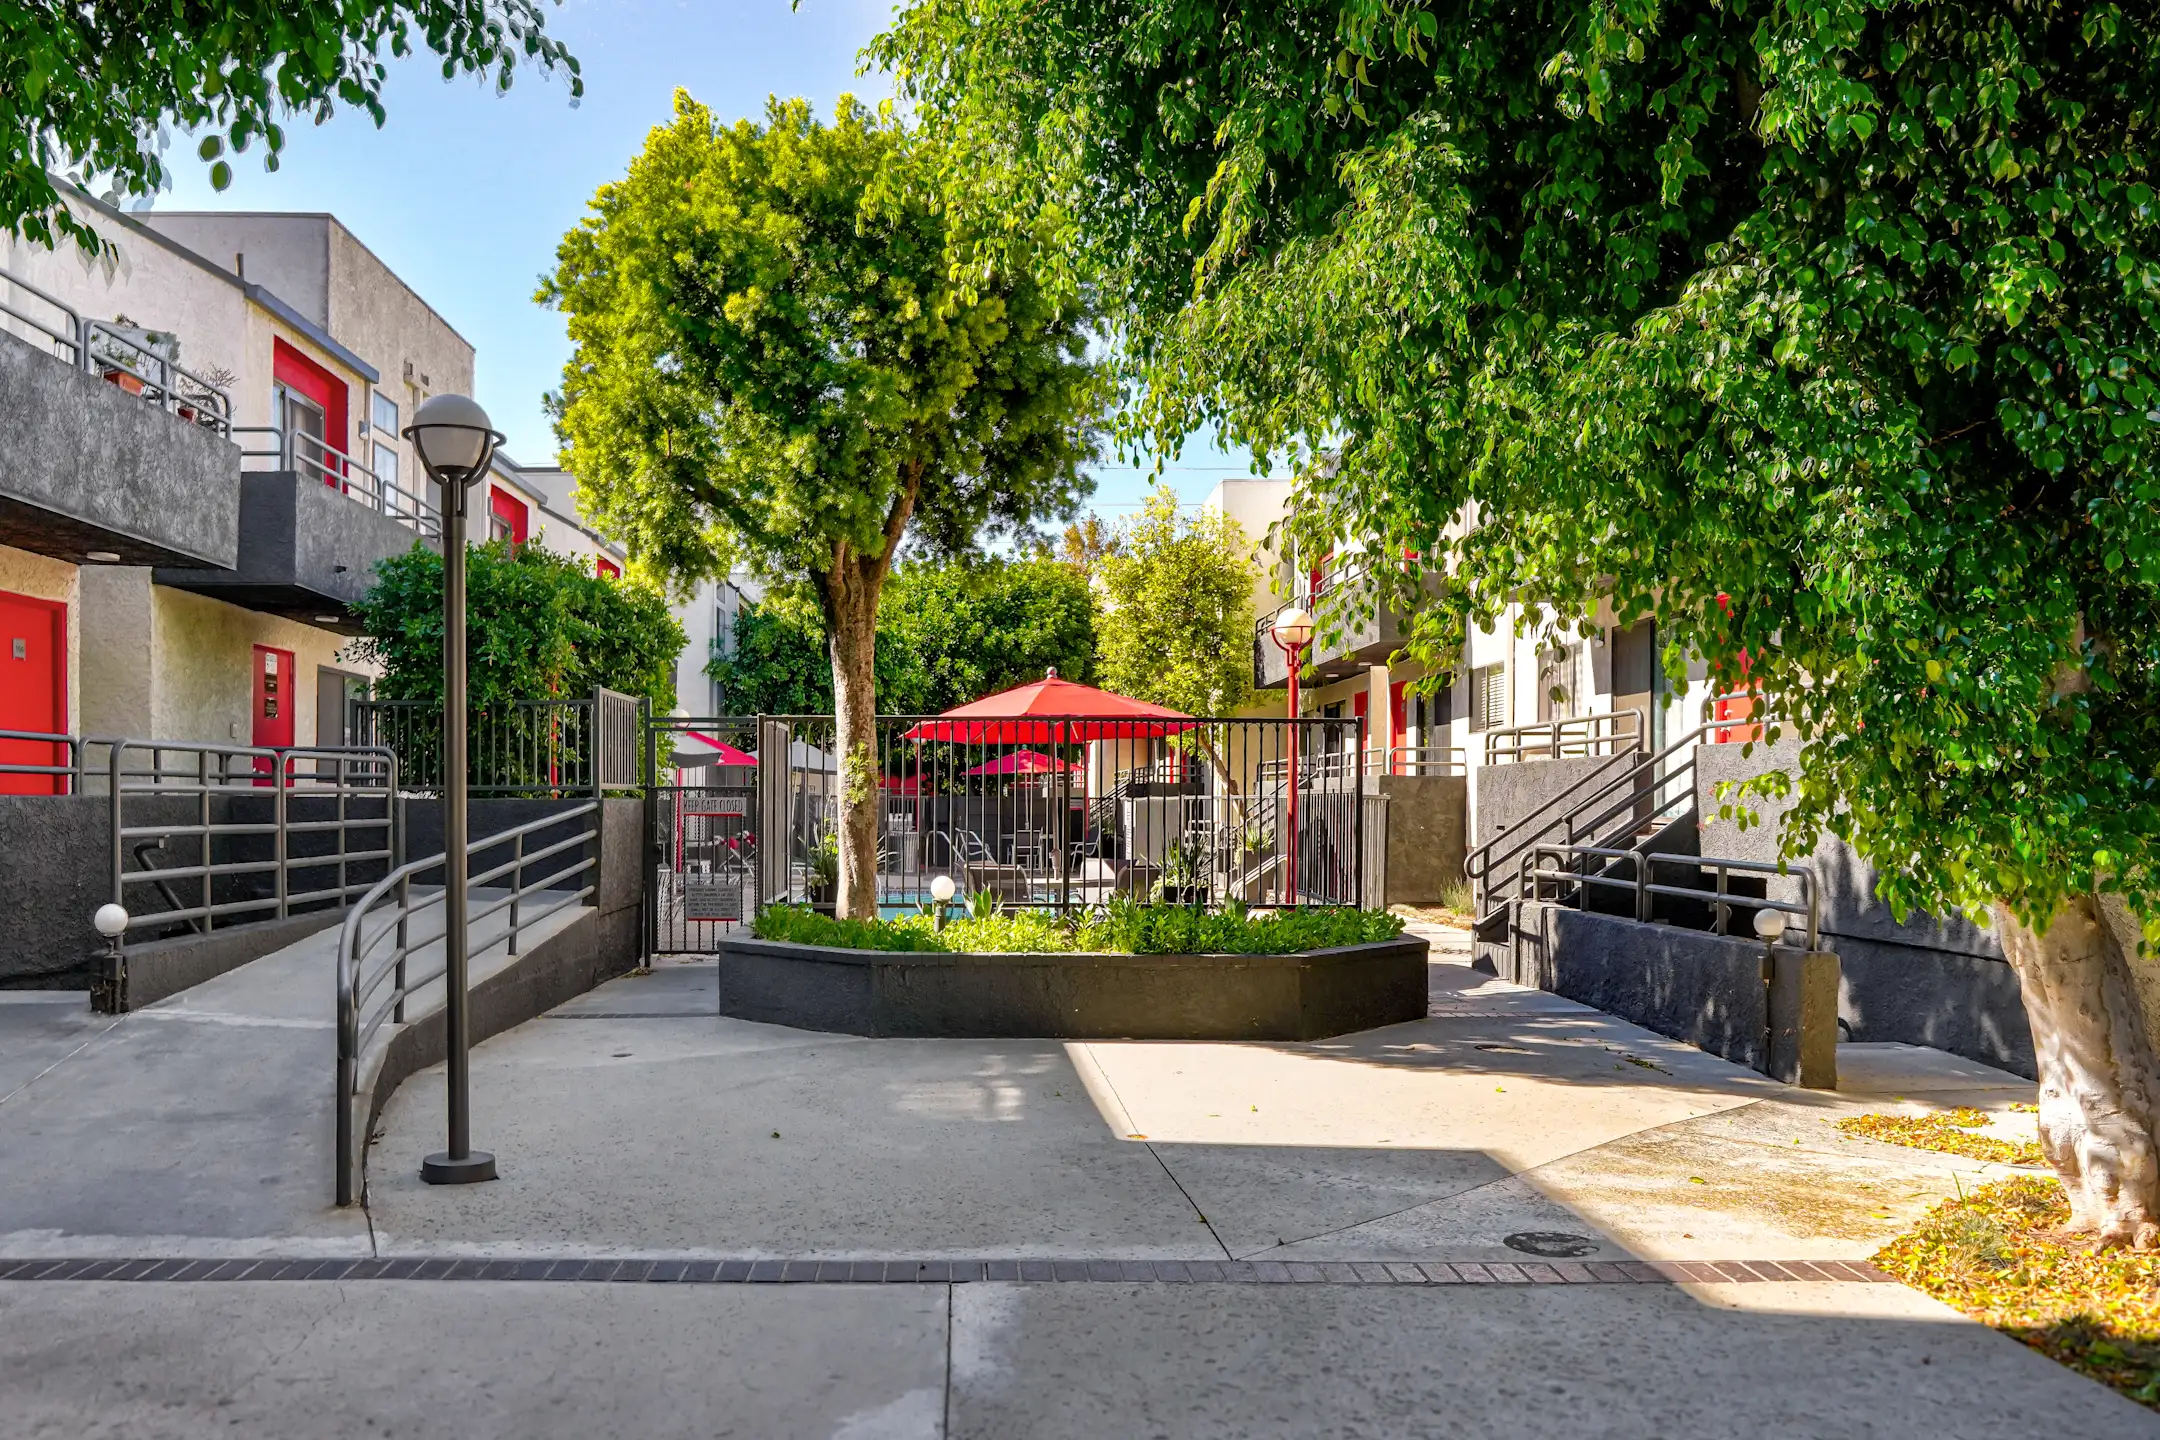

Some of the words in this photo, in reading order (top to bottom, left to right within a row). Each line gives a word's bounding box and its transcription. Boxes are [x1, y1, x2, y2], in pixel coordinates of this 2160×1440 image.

[684, 799, 699, 812] KEEP
[702, 799, 717, 812] GATE
[720, 799, 743, 812] CLOSED
